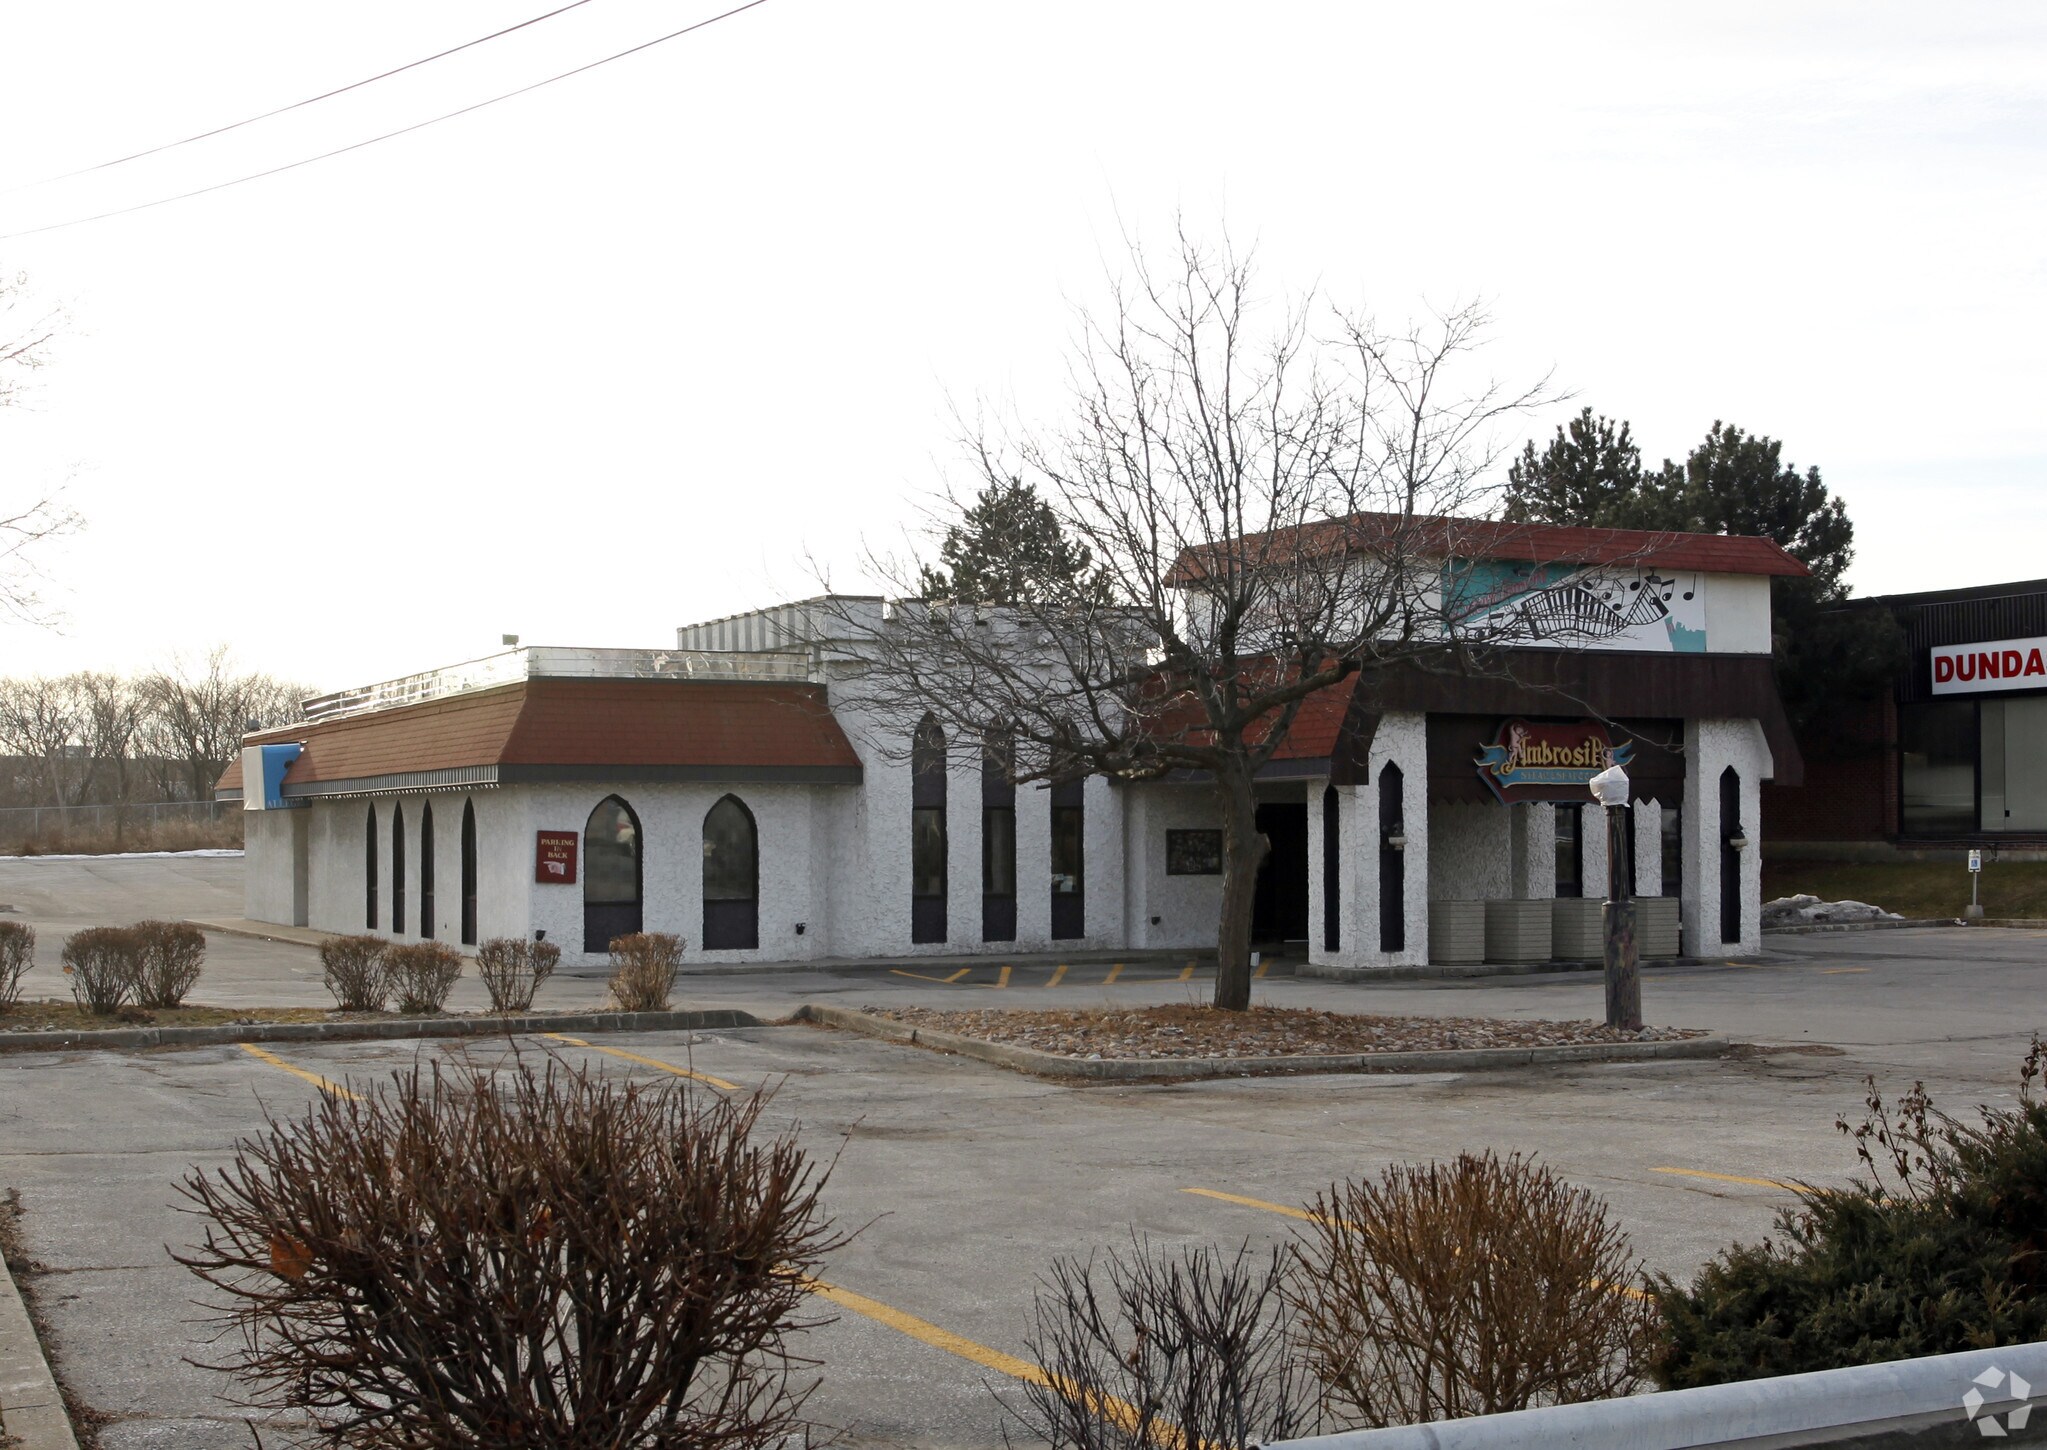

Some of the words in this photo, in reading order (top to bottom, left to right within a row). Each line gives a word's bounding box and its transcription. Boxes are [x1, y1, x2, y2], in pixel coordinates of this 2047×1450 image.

[1934, 648, 2047, 683] DUNDA
[541, 838, 575, 846] PARKING
[547, 851, 568, 859] BACK
